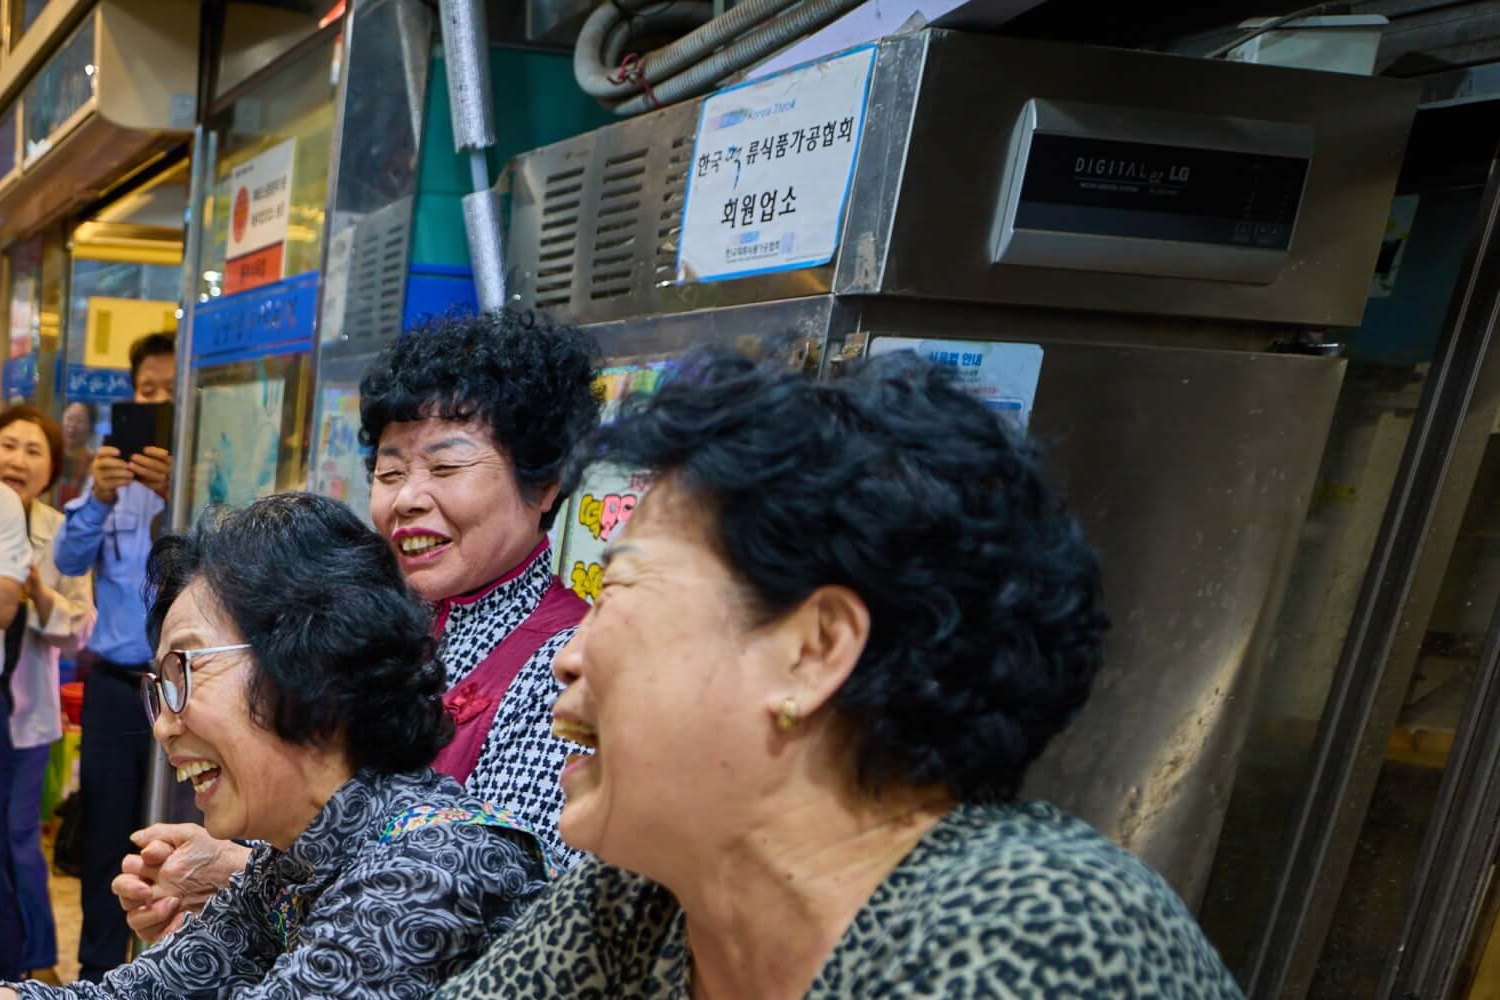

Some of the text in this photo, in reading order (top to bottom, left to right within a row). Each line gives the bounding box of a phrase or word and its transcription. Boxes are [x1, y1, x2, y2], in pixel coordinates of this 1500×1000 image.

[1075, 157, 1148, 178] DIGITAL
[1169, 165, 1190, 182] LG
[720, 186, 797, 229] 회원업소
